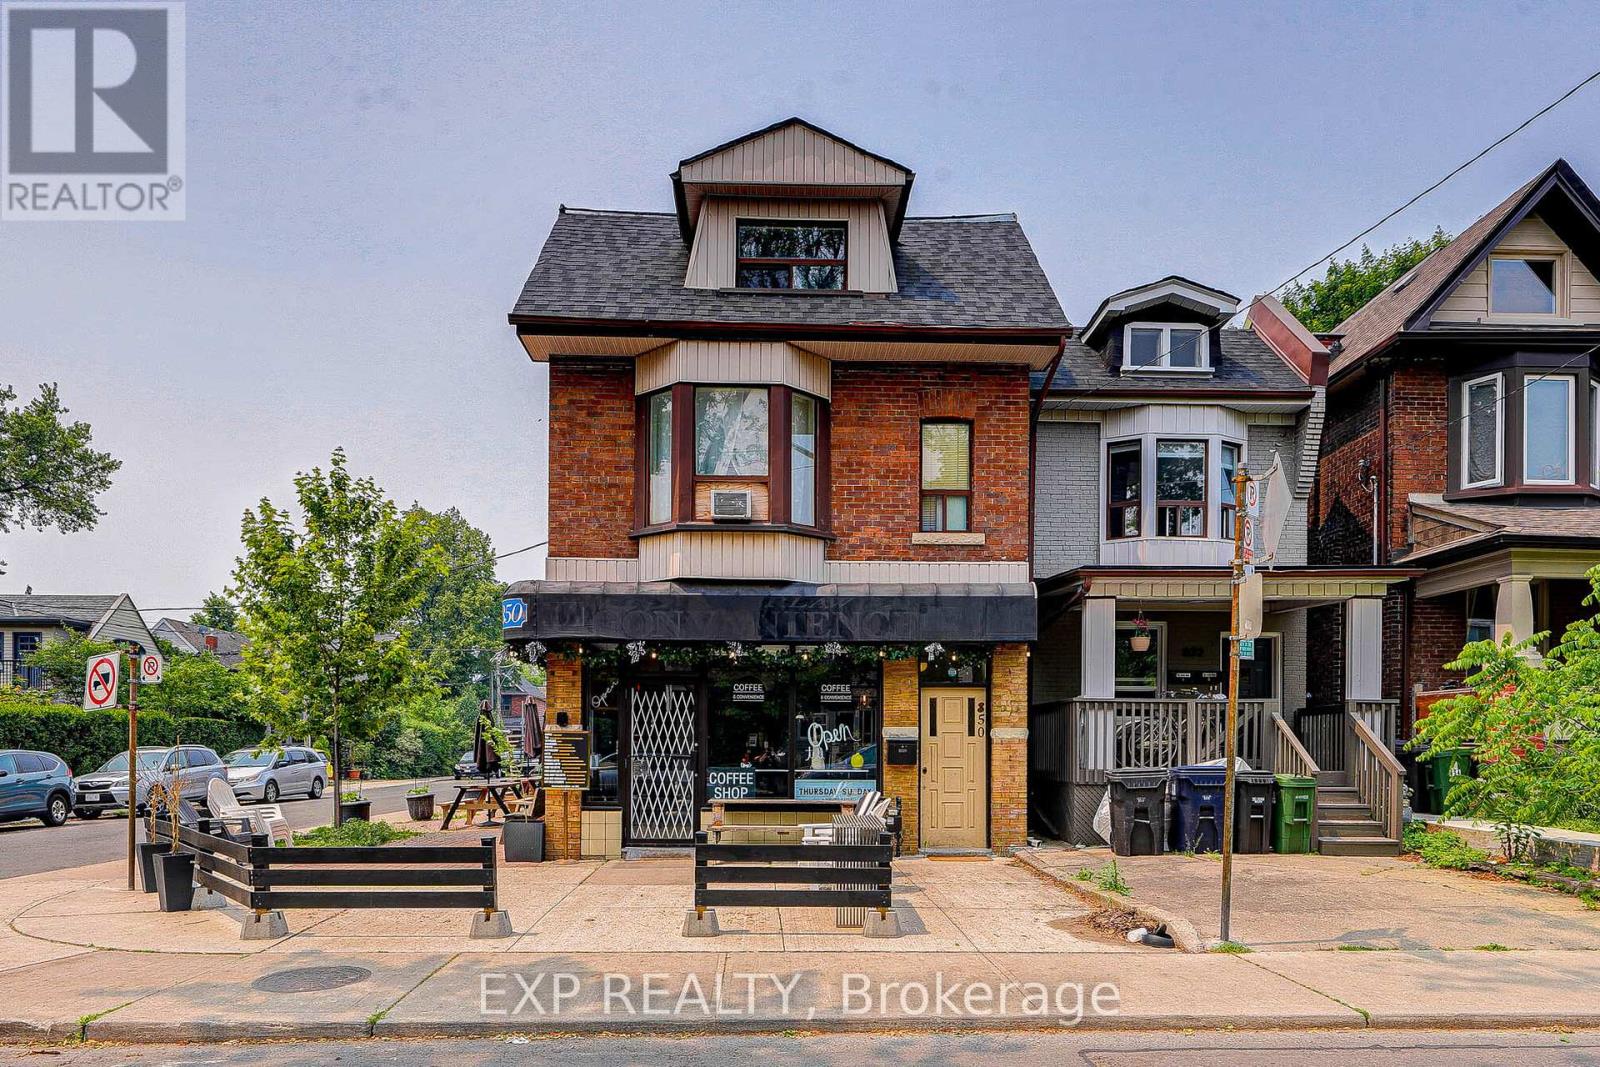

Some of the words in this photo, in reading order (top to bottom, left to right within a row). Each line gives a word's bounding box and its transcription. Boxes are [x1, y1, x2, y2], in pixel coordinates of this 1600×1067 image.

[733, 683, 763, 692] COFFEE
[821, 684, 851, 692] COFFEE
[977, 702, 985, 738] 850
[807, 722, 861, 751] Open
[709, 772, 754, 785] COFFEE
[714, 787, 749, 800] SHOP
[799, 788, 837, 796] THURSDAY
